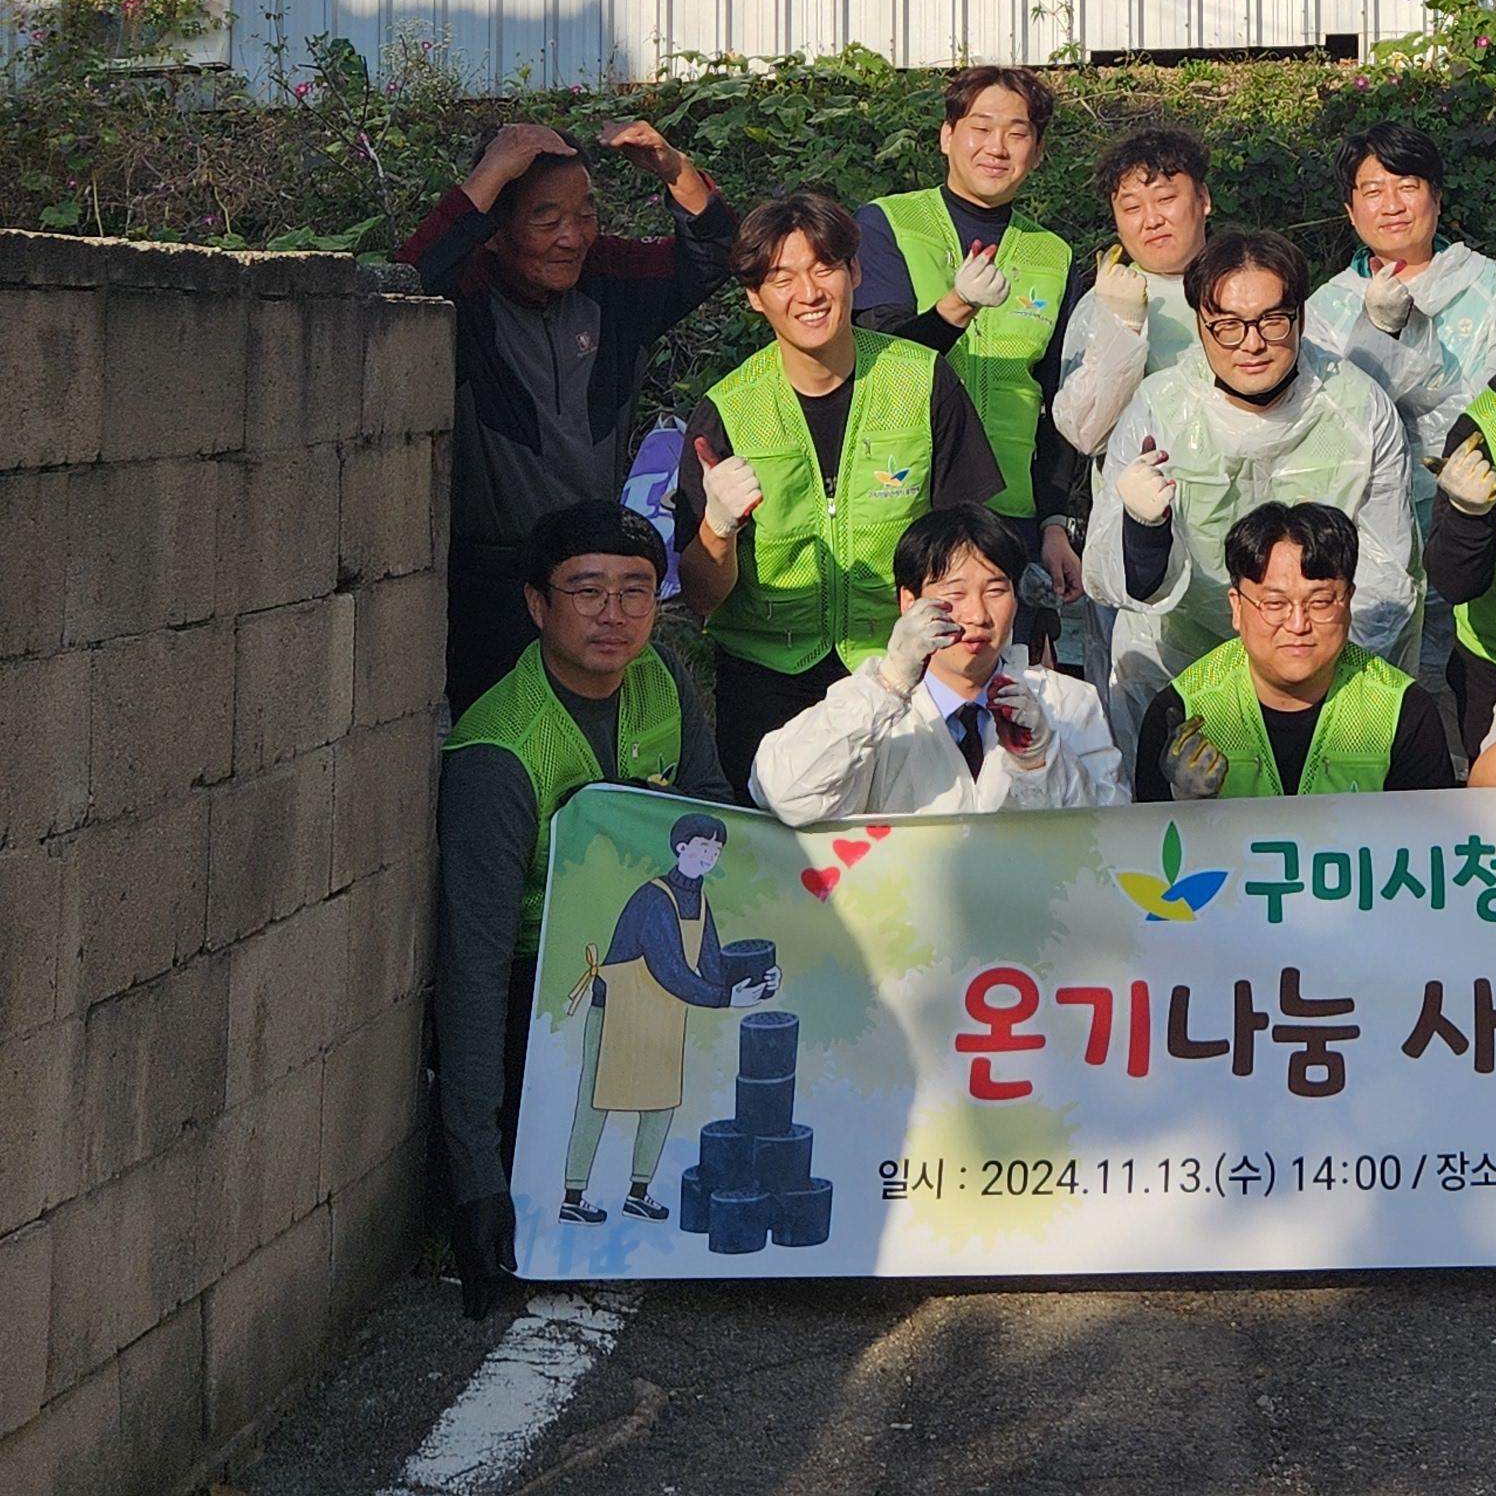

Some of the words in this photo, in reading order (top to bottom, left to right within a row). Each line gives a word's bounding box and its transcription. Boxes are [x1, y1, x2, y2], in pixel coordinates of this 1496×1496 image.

[953, 966, 1360, 1101] 온기나눔
[878, 1157, 944, 1201] 일시
[1290, 1153, 1403, 1193] 14:00
